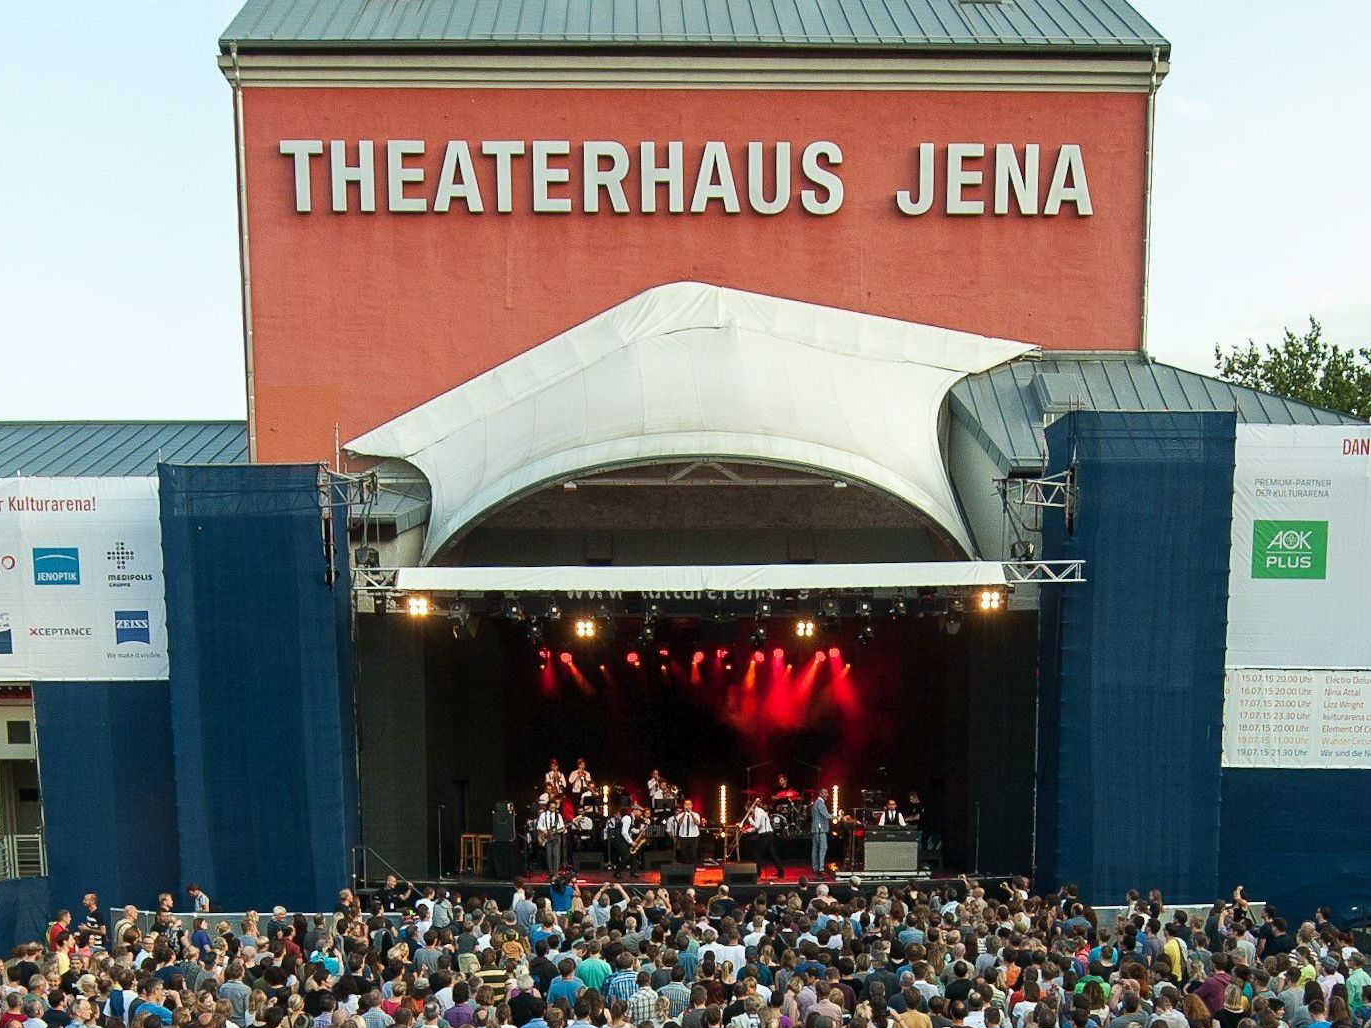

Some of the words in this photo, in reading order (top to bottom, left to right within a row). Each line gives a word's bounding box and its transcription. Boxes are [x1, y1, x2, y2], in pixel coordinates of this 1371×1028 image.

[280, 139, 844, 216] THEATERHAUS
[895, 141, 1093, 217] JENA
[1254, 478, 1332, 488] PREMIUM-PARTNER
[1255, 489, 1271, 498] DER
[1273, 489, 1330, 498] KULTURARENA
[8, 496, 97, 512] Kulturarena!
[1266, 530, 1313, 550] AOK
[1266, 556, 1312, 569] PLUS
[37, 572, 78, 581] JENOPTIK
[116, 619, 149, 629] ZEISS
[29, 627, 92, 636] XCEPTANCE
[1297, 700, 1312, 708] Uhr
[1323, 713, 1365, 721] kulturarena
[1294, 749, 1308, 757] Uhr
